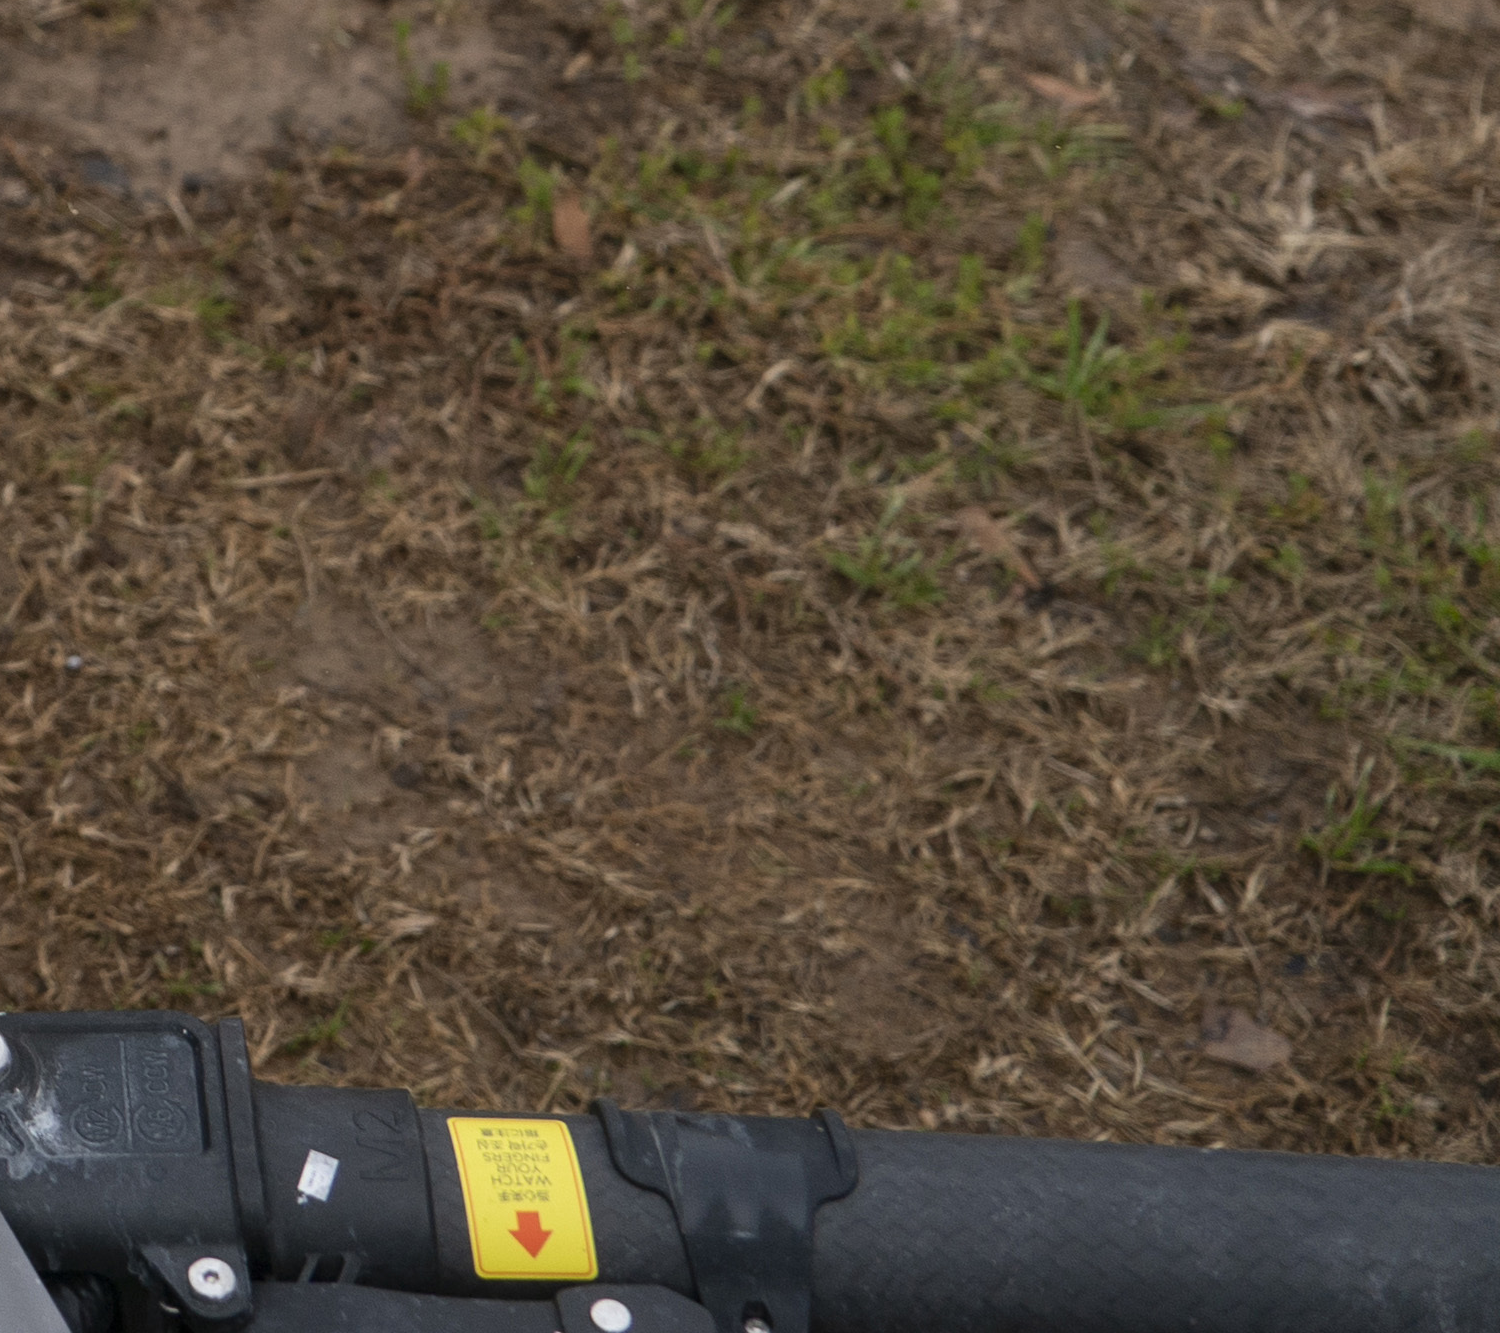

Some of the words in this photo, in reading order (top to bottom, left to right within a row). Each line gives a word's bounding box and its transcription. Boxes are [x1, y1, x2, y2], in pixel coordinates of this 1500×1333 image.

[352, 1109, 410, 1182] M2
[483, 1152, 550, 1162] FINGERS
[497, 1163, 541, 1174] YOUR
[491, 1174, 553, 1186] WATCH
